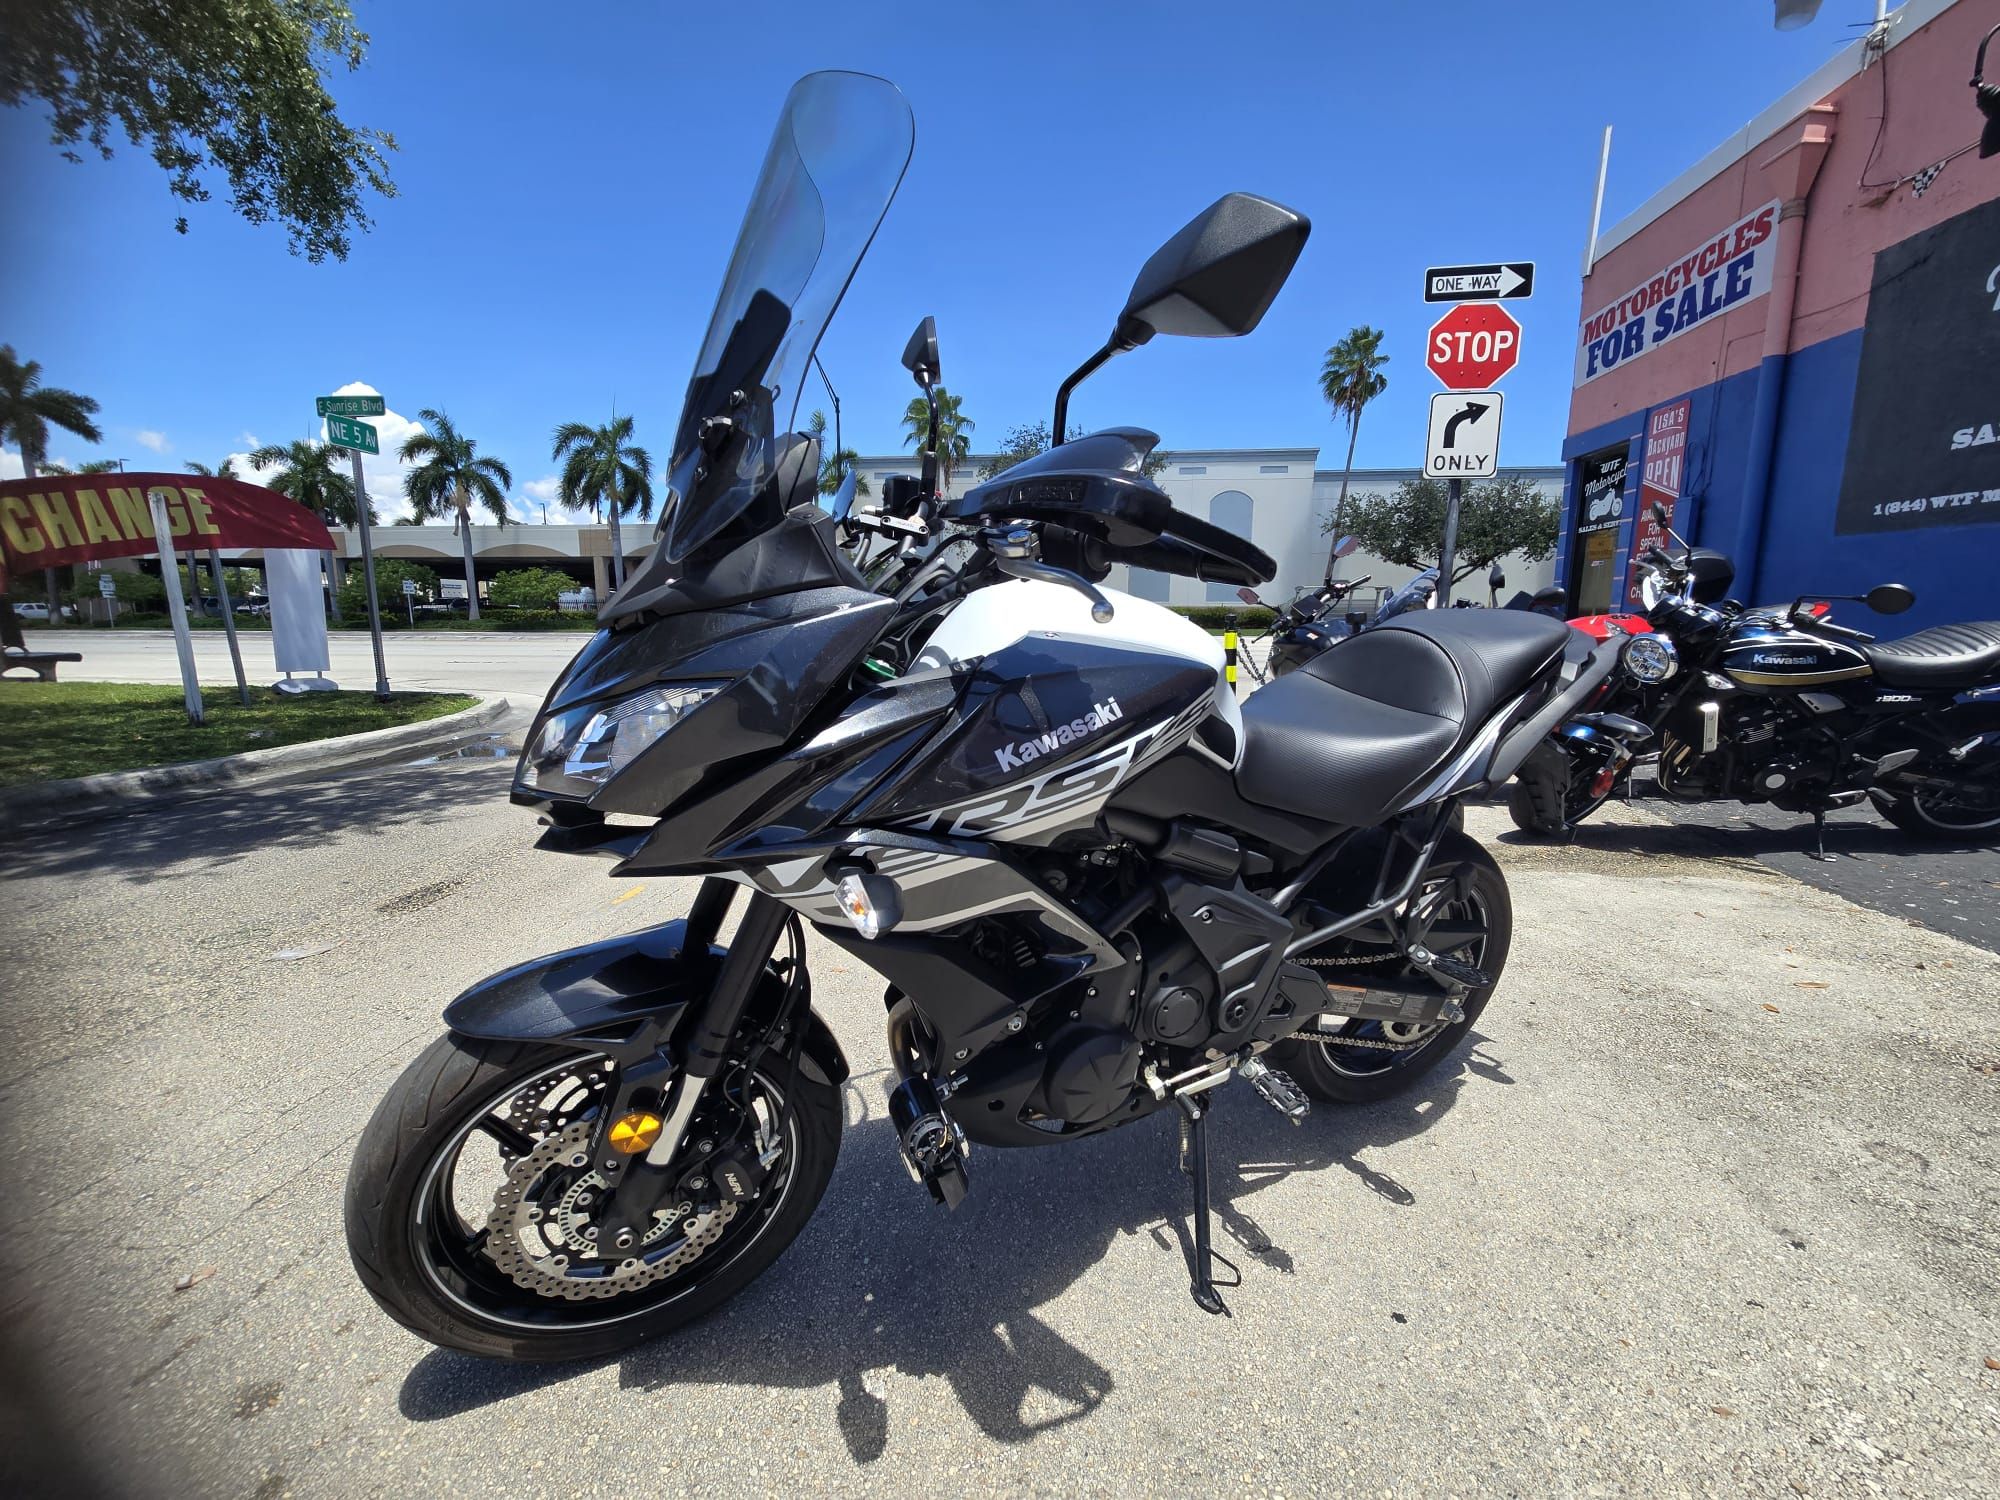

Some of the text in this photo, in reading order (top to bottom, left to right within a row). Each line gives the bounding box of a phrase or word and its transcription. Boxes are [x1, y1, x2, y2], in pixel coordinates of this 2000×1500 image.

[1435, 274, 1502, 292] ONE WAY
[1582, 206, 1775, 347] MOTORCYCLES
[1586, 250, 1755, 379] FOR SALE
[1433, 330, 1514, 364] STOP
[318, 399, 383, 413] E Sunrise Blvd
[330, 420, 350, 441] NE
[353, 426, 362, 444] 5
[1652, 407, 1685, 435] LISA'S
[1647, 431, 1686, 457] BACKYARD
[1433, 454, 1490, 472] ONLY
[1600, 457, 1622, 474] WTF
[1645, 454, 1681, 490] OPEN
[1873, 503, 1883, 516] 1
[1884, 498, 1928, 516] (844)
[1929, 491, 1980, 509] WTF
[0, 486, 221, 566] CHANGE
[1753, 653, 1818, 665] Kawasaki
[993, 695, 1125, 774] Kawasaki
